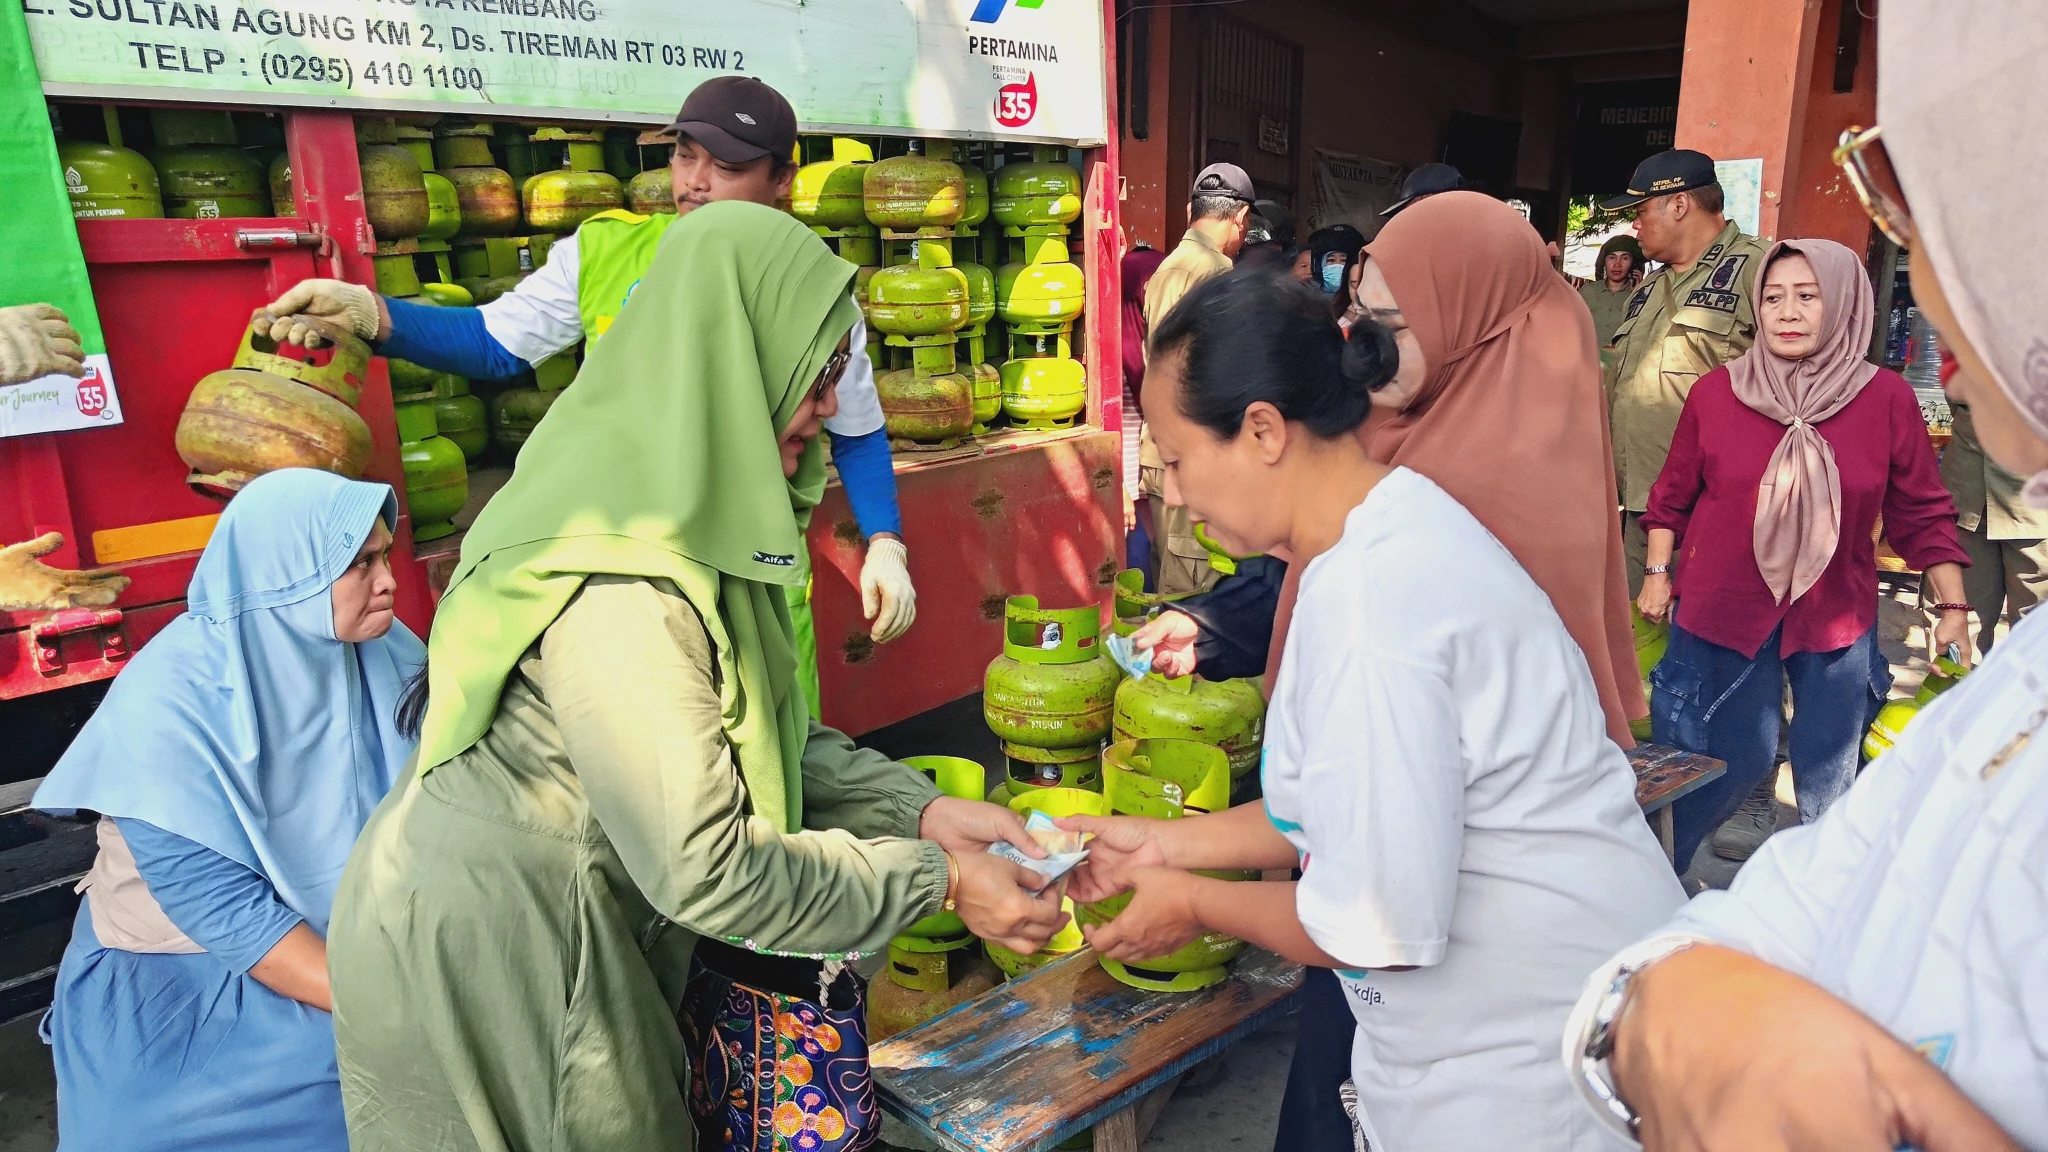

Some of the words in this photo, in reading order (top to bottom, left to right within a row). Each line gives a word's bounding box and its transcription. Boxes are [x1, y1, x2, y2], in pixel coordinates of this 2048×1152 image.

[68, 0, 220, 31] SULTAN
[232, 7, 356, 41] AGUNG
[365, 18, 411, 46] KM
[419, 23, 443, 52] 2,
[451, 26, 495, 52] Ds.
[500, 30, 618, 60] TIREMAN
[625, 40, 655, 64] RT
[662, 44, 687, 66] 03
[692, 47, 727, 69] RW
[733, 50, 745, 71] 2
[969, 35, 1058, 63] PERTAMINA
[128, 41, 225, 75] TELP
[261, 52, 354, 90] (0295)
[363, 60, 414, 87] 410
[423, 64, 484, 91] 1100
[992, 65, 1026, 75] PERTAMINA
[992, 73, 1006, 81] CALL
[995, 91, 1031, 120] 135
[1688, 292, 1713, 305] POL
[1714, 294, 1735, 308] PP
[11, 387, 60, 410] Journey
[76, 386, 104, 411] 135
[764, 556, 784, 565] alfa
